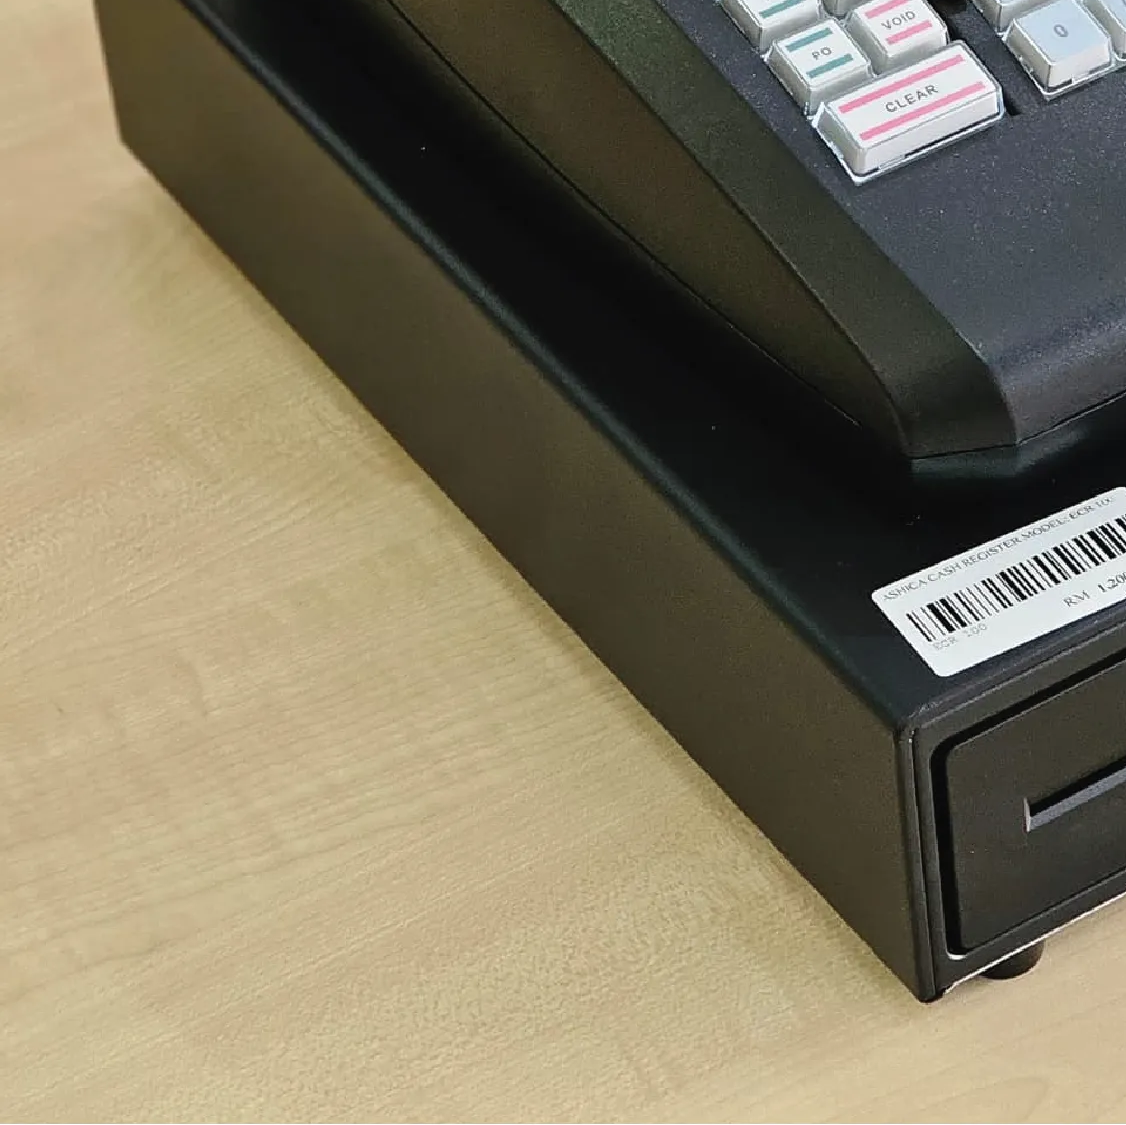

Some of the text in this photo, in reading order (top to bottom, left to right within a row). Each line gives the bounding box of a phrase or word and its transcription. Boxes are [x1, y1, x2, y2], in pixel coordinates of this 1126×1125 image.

[881, 10, 916, 30] VOID
[1053, 23, 1068, 38] 0
[811, 47, 832, 60] PO
[885, 85, 939, 113] CLEAR
[928, 561, 962, 582] CASH
[962, 537, 1022, 567] REGISTER
[1069, 505, 1095, 519] ECR
[1063, 590, 1091, 608] RM
